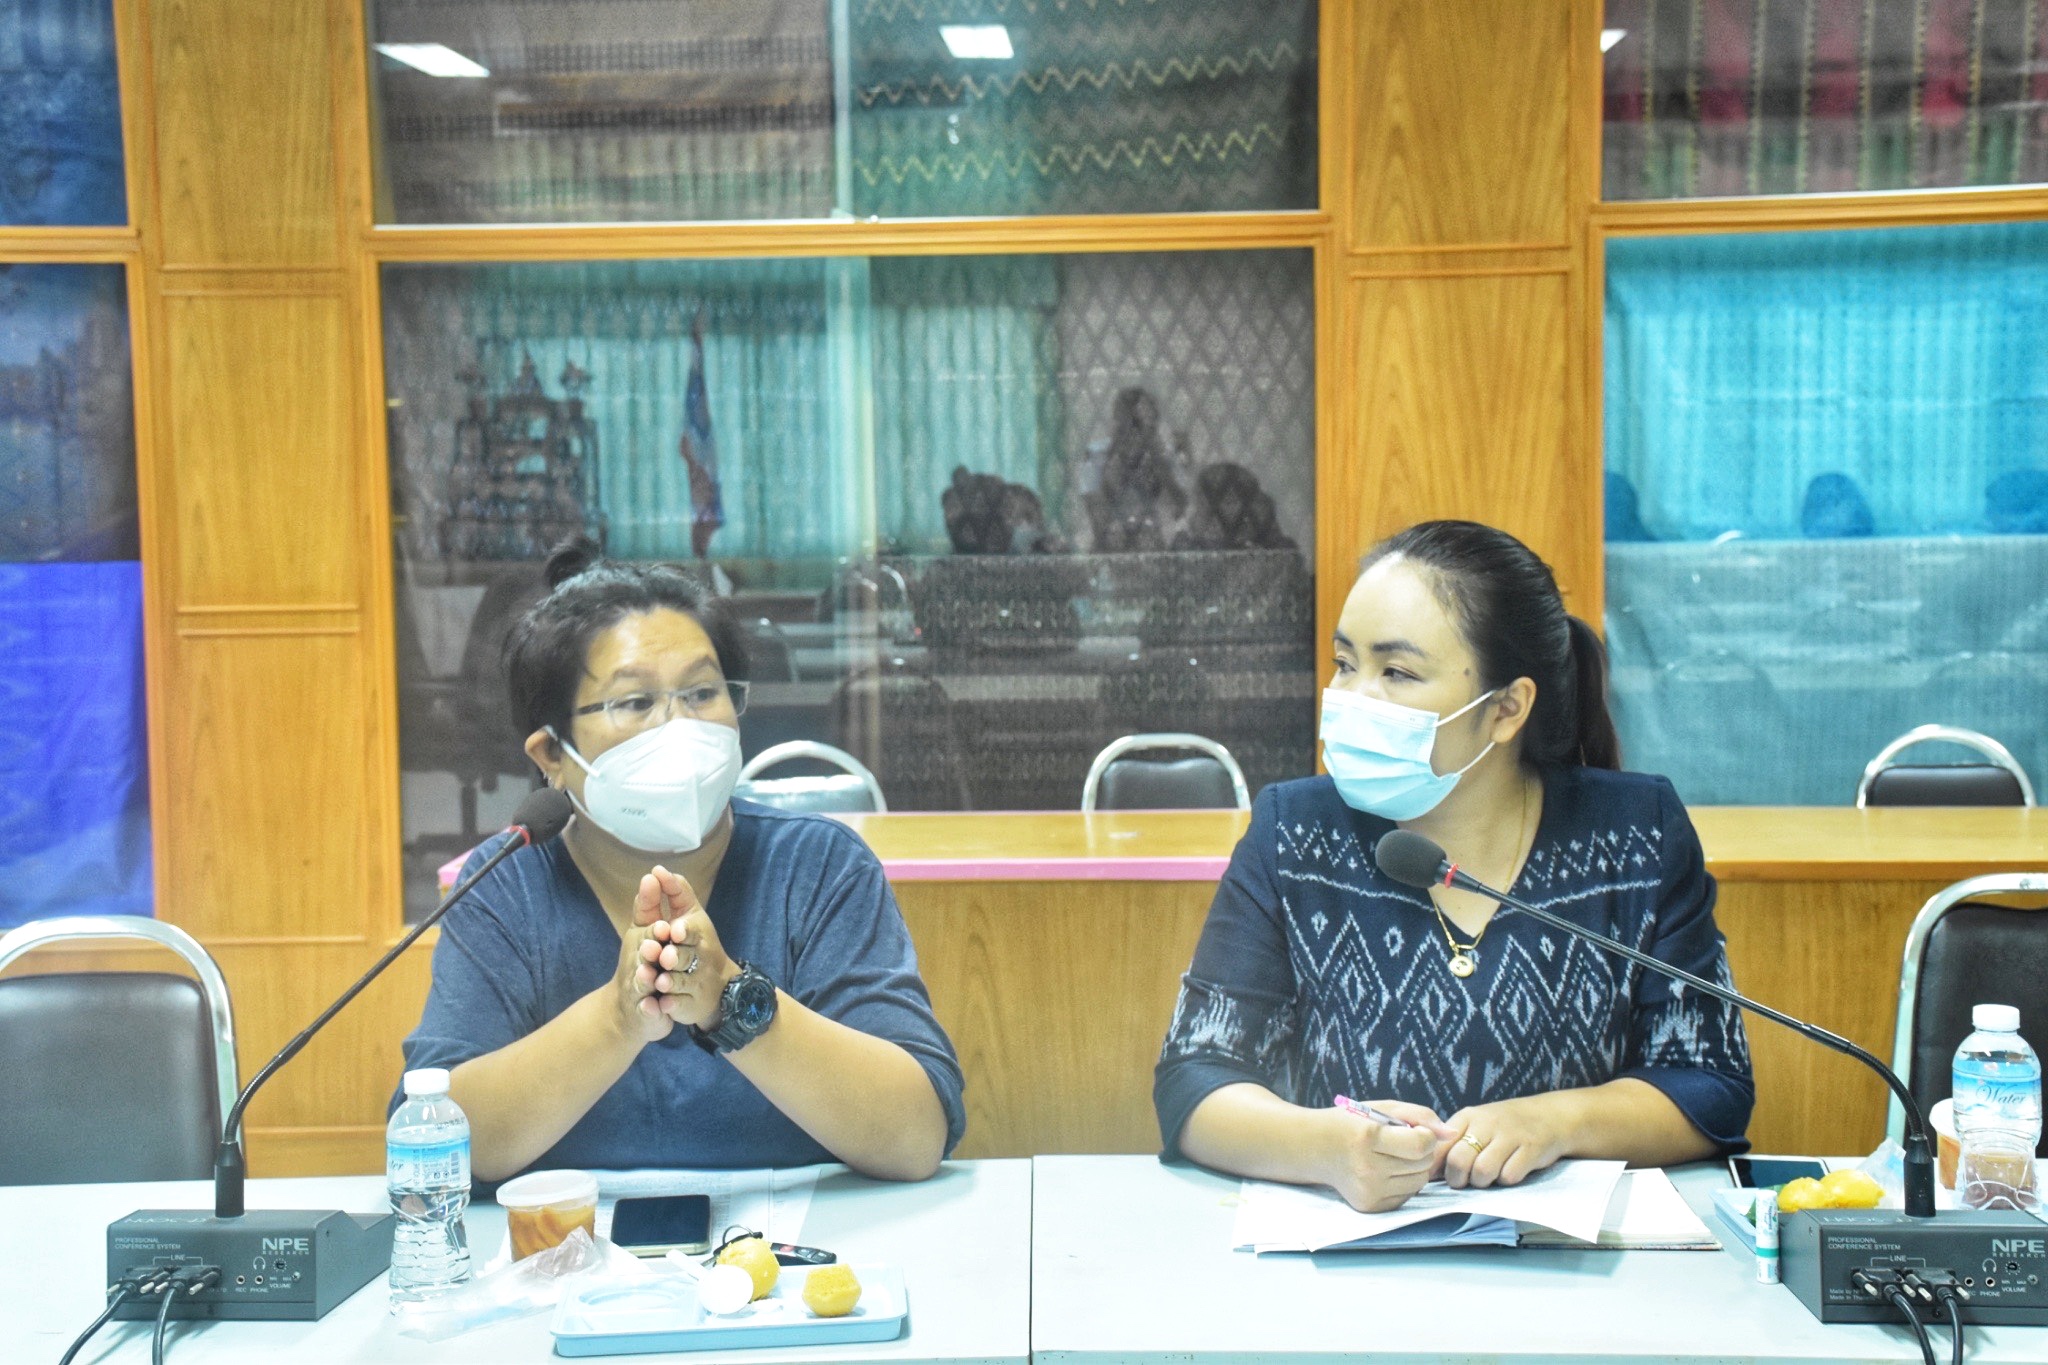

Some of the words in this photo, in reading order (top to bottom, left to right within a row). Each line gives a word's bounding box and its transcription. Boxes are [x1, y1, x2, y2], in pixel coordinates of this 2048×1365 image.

[1976, 1084, 2026, 1103] Water
[262, 1238, 309, 1251] NPE
[1992, 1239, 2046, 1253] NPE
